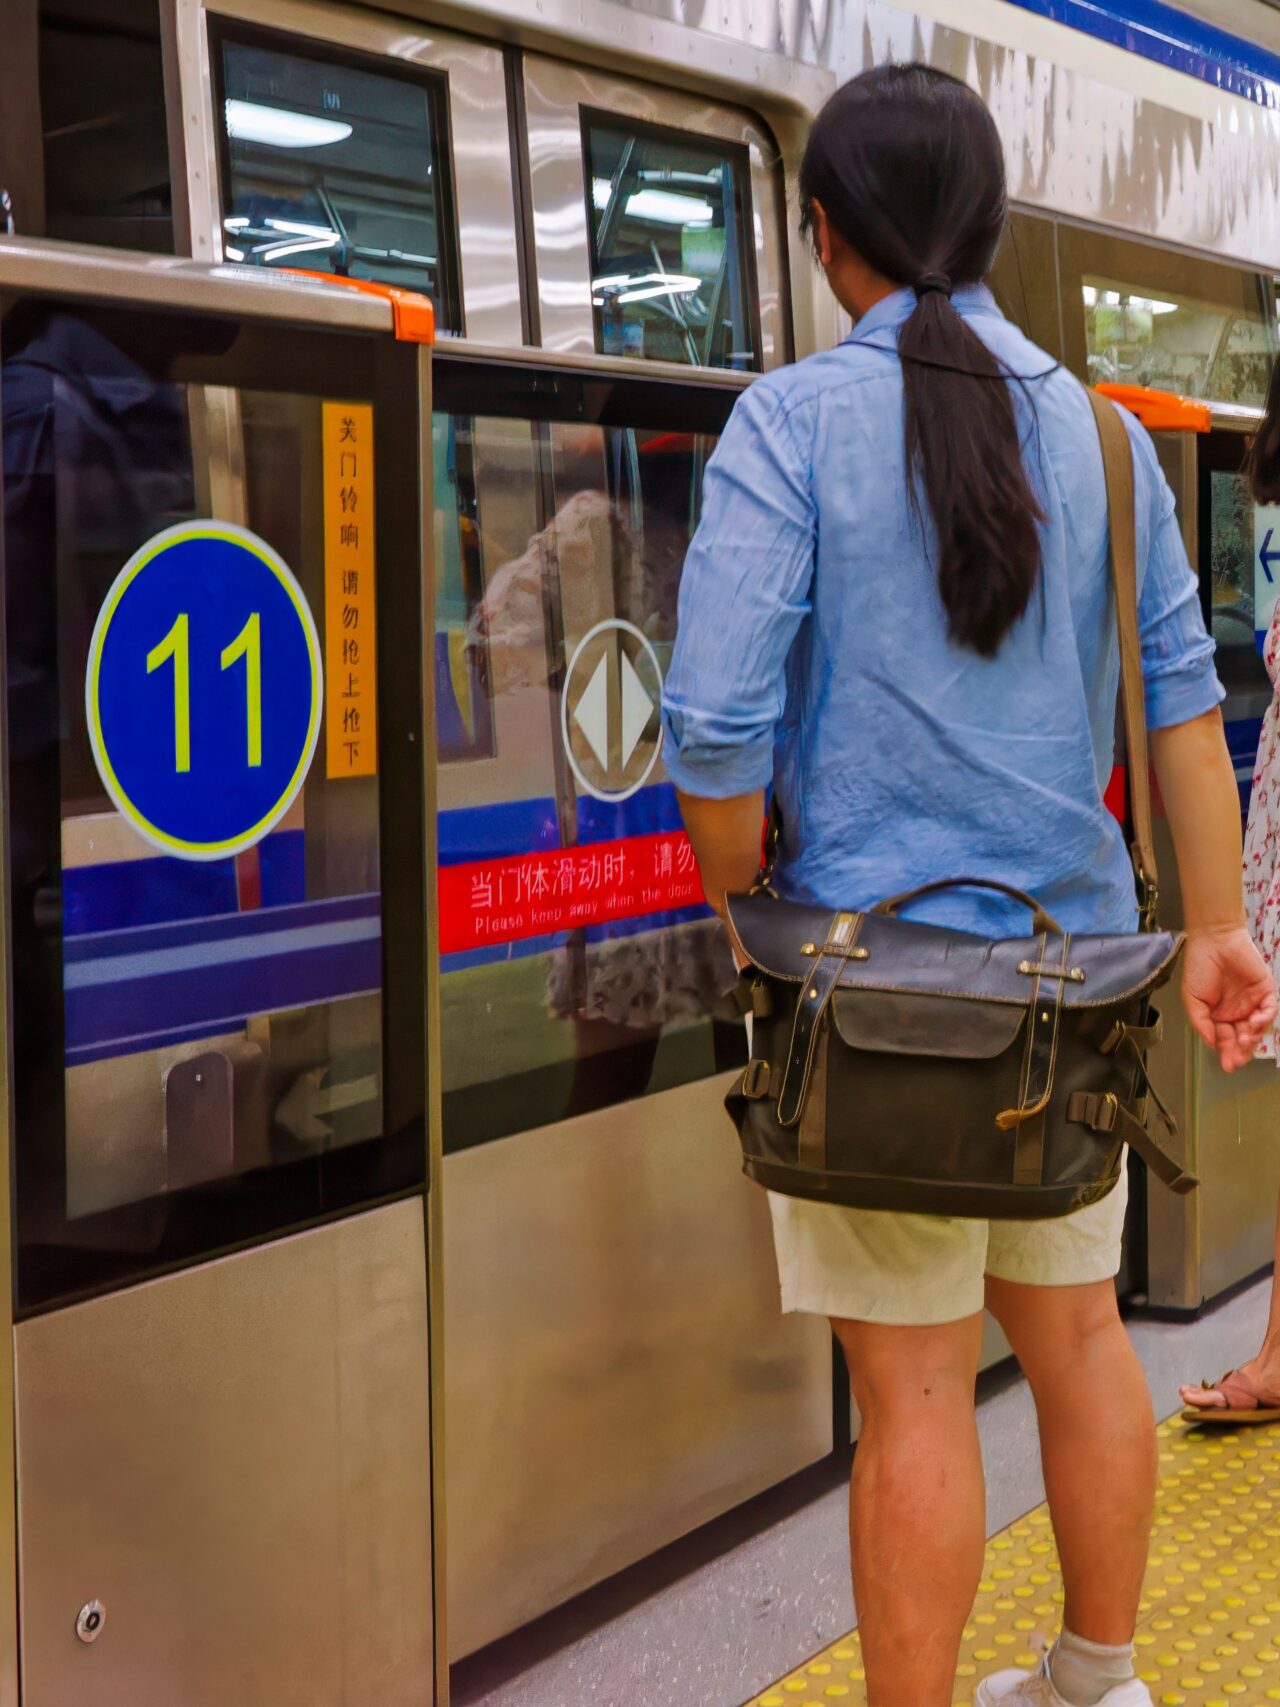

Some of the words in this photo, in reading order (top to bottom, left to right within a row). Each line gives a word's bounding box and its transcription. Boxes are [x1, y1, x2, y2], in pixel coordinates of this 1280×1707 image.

[339, 417, 358, 549] 关门铃响
[146, 612, 262, 773] 11
[475, 915, 524, 935] Please
[531, 907, 562, 925] keep
[569, 901, 598, 918] away
[605, 894, 635, 910] when
[642, 888, 662, 905] the
